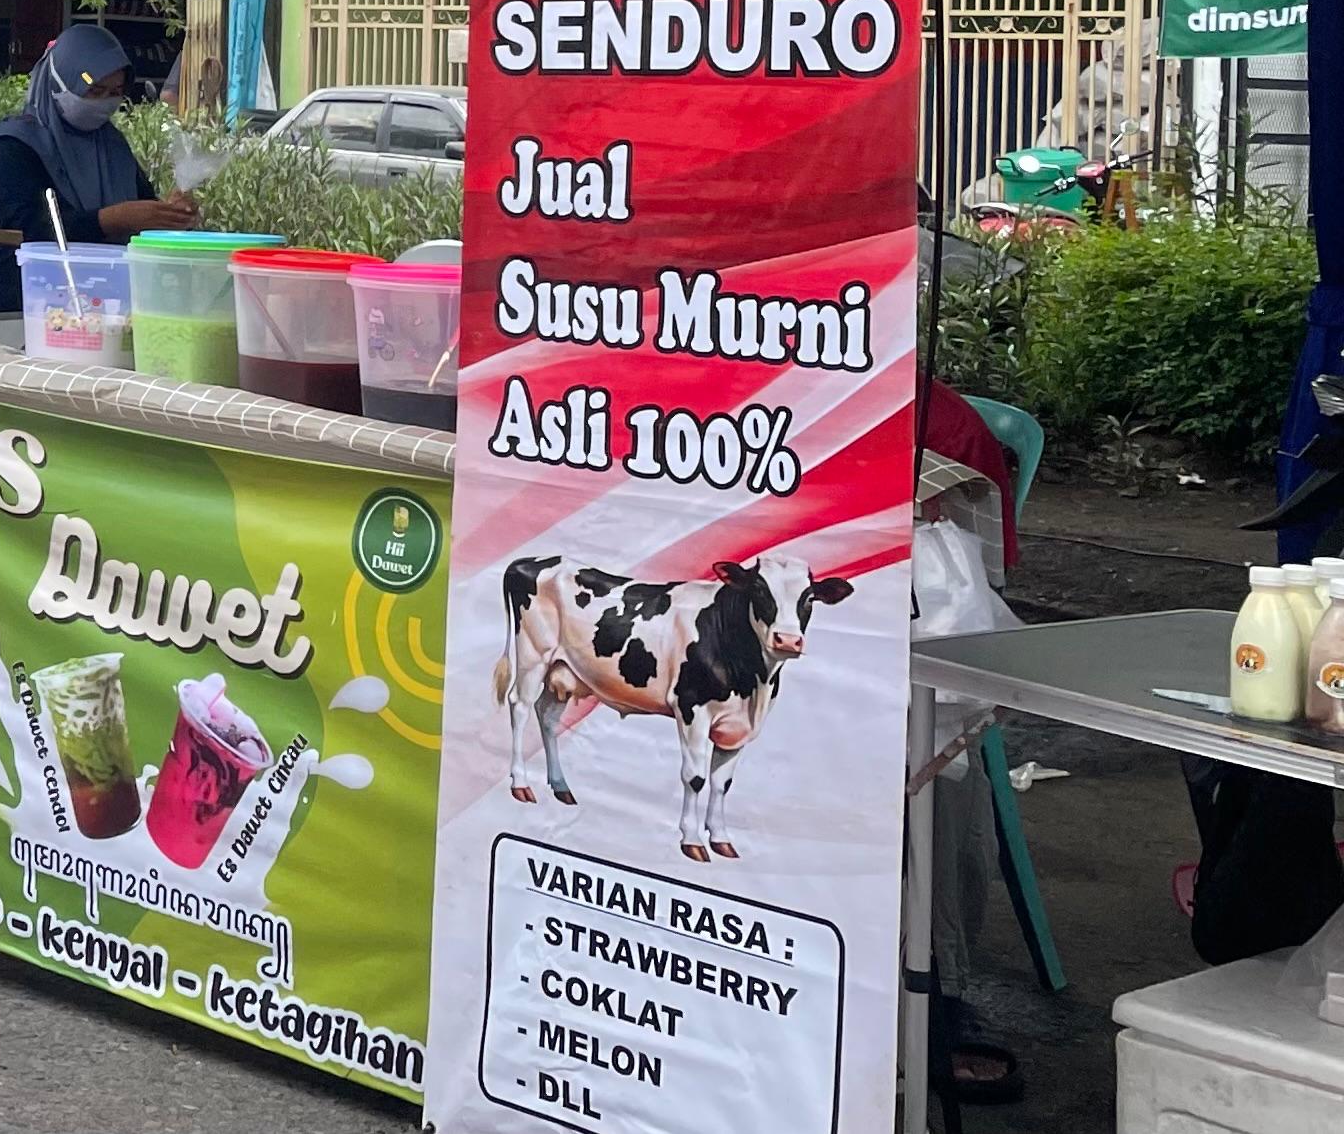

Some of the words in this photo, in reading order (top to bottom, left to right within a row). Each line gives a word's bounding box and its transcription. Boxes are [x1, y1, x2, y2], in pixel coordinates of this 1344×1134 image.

[499, 137, 633, 223] Jual
[496, 260, 644, 348] Susu
[654, 270, 872, 372] Murni
[488, 377, 612, 472] Asli
[622, 403, 802, 498] 100%
[28, 514, 314, 680] Dawet
[372, 555, 413, 575] Dawet
[21, 690, 47, 759] Dawet
[217, 857, 237, 883] Es
[231, 796, 273, 858] Dawet
[268, 733, 309, 795] Cincau
[527, 858, 656, 921] VARIAN
[671, 898, 770, 955] RASA
[43, 913, 163, 991] kenyal
[213, 973, 424, 1084] ketagihan
[541, 970, 684, 1037] COKLAT
[544, 917, 798, 1016] STRAWBERRY
[538, 1019, 662, 1087] MELON
[538, 1071, 602, 1120] DLL
